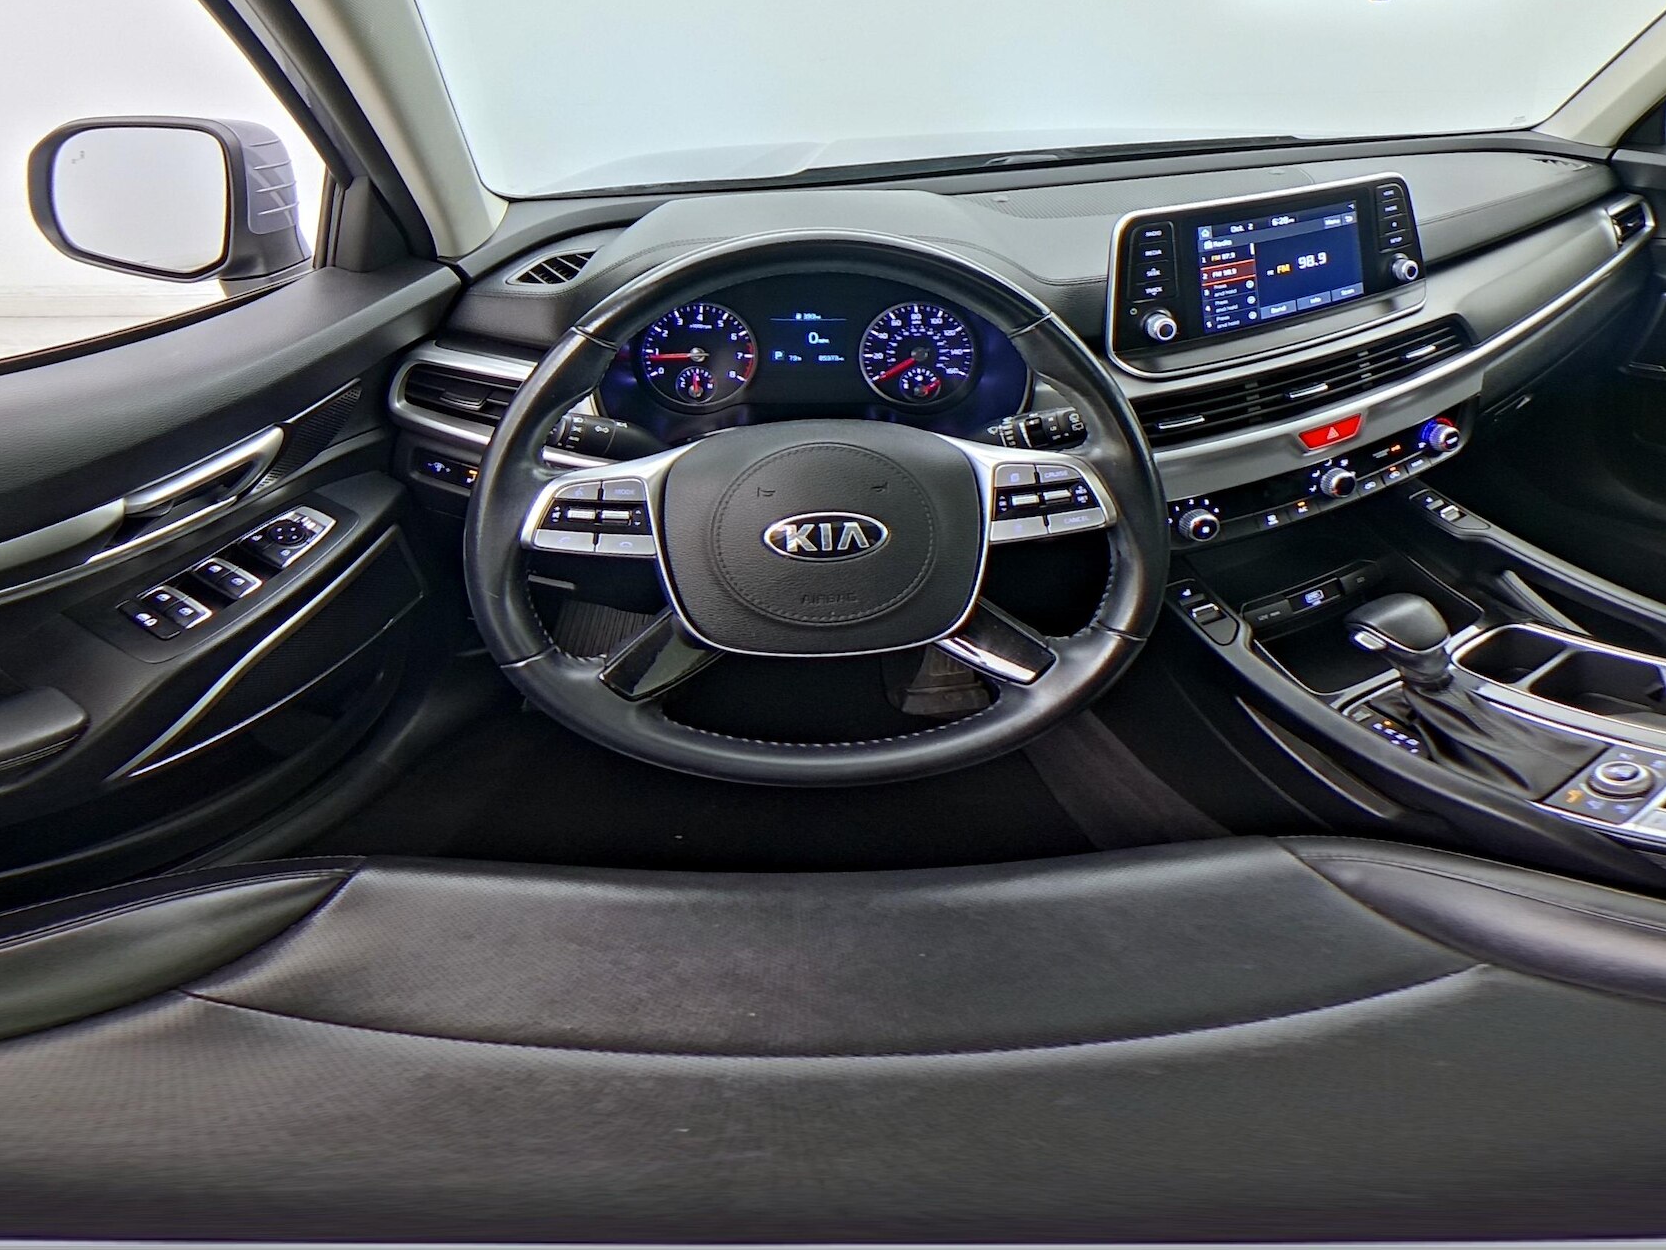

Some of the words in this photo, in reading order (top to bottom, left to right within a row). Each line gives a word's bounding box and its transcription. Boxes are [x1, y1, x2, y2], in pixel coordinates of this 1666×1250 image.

[1277, 263, 1291, 273] FM
[1298, 252, 1327, 269] 98.9
[1271, 305, 1287, 313] Band
[784, 521, 870, 553] KIA
[800, 591, 859, 604] AIRBAG
